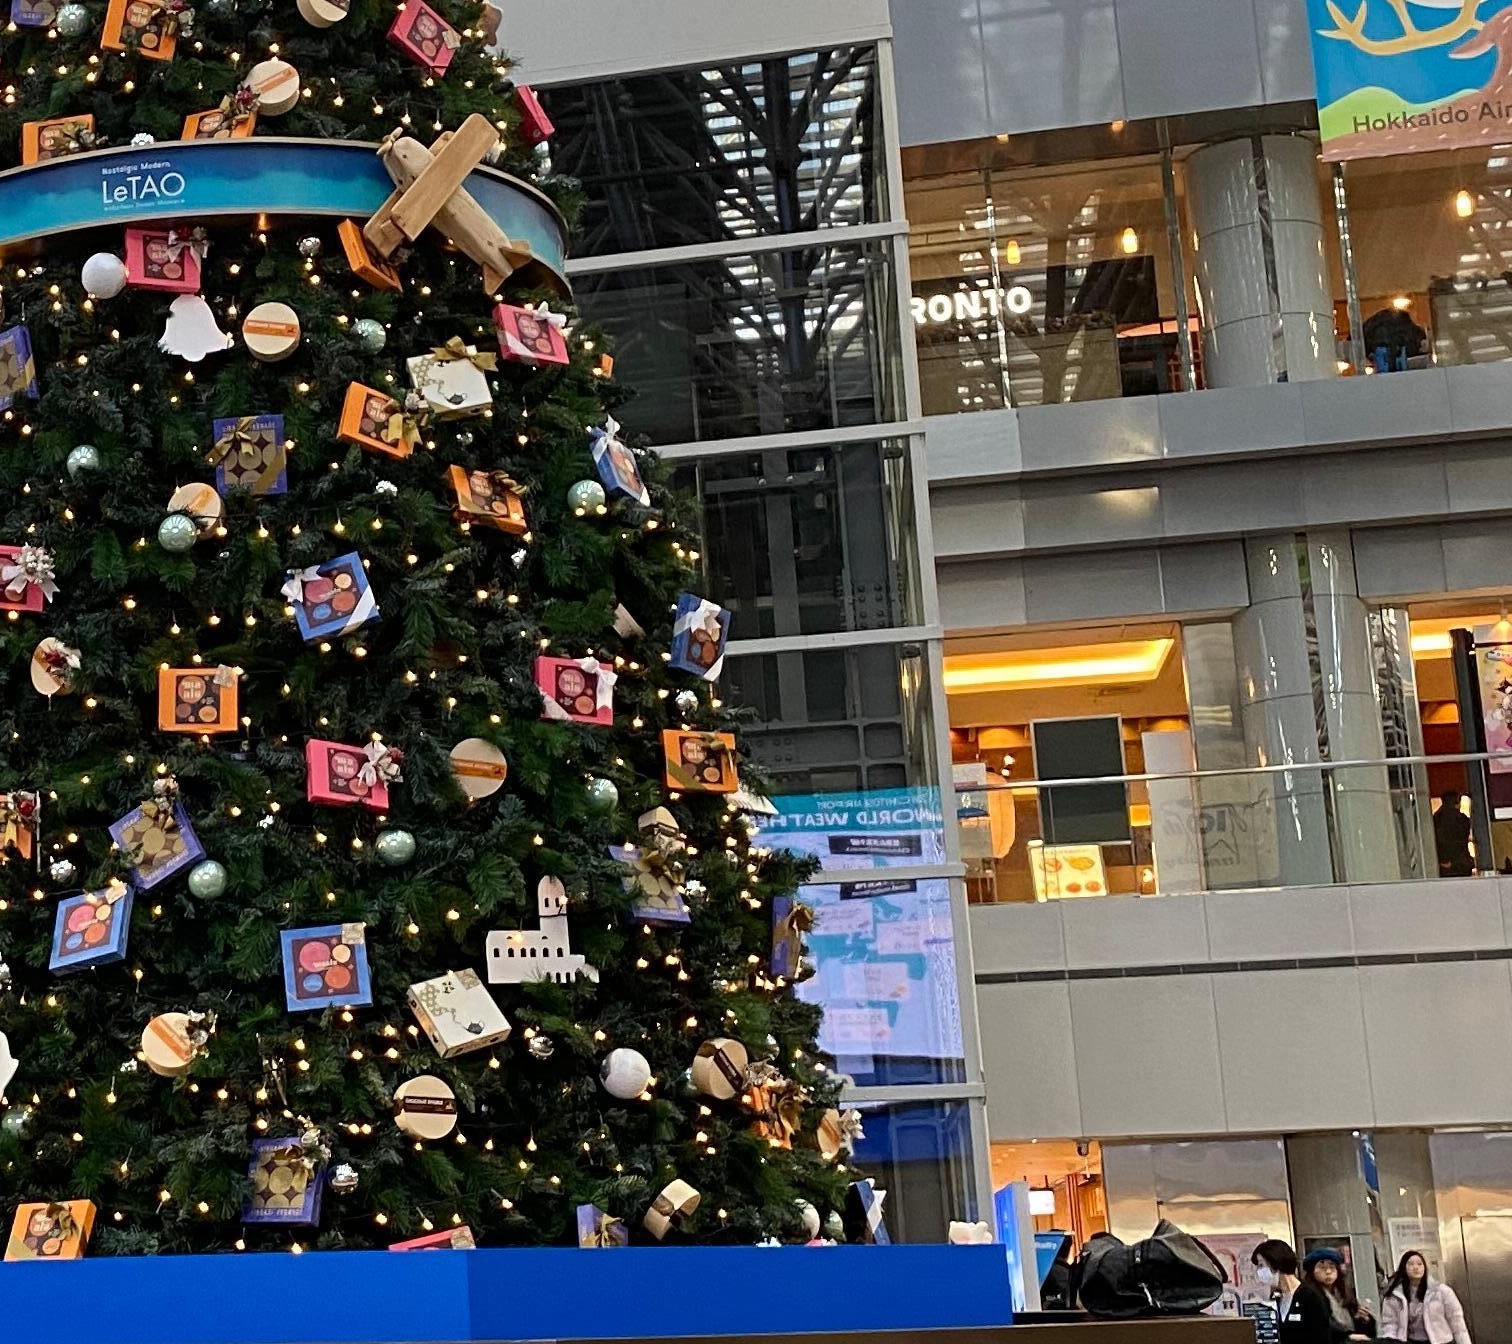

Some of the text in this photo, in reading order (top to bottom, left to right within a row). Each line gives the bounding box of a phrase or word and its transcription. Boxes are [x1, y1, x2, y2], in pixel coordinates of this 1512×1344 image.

[1352, 105, 1469, 134] Hokkaido
[102, 164, 138, 175] Nostalgic
[102, 172, 185, 204] LeTAO
